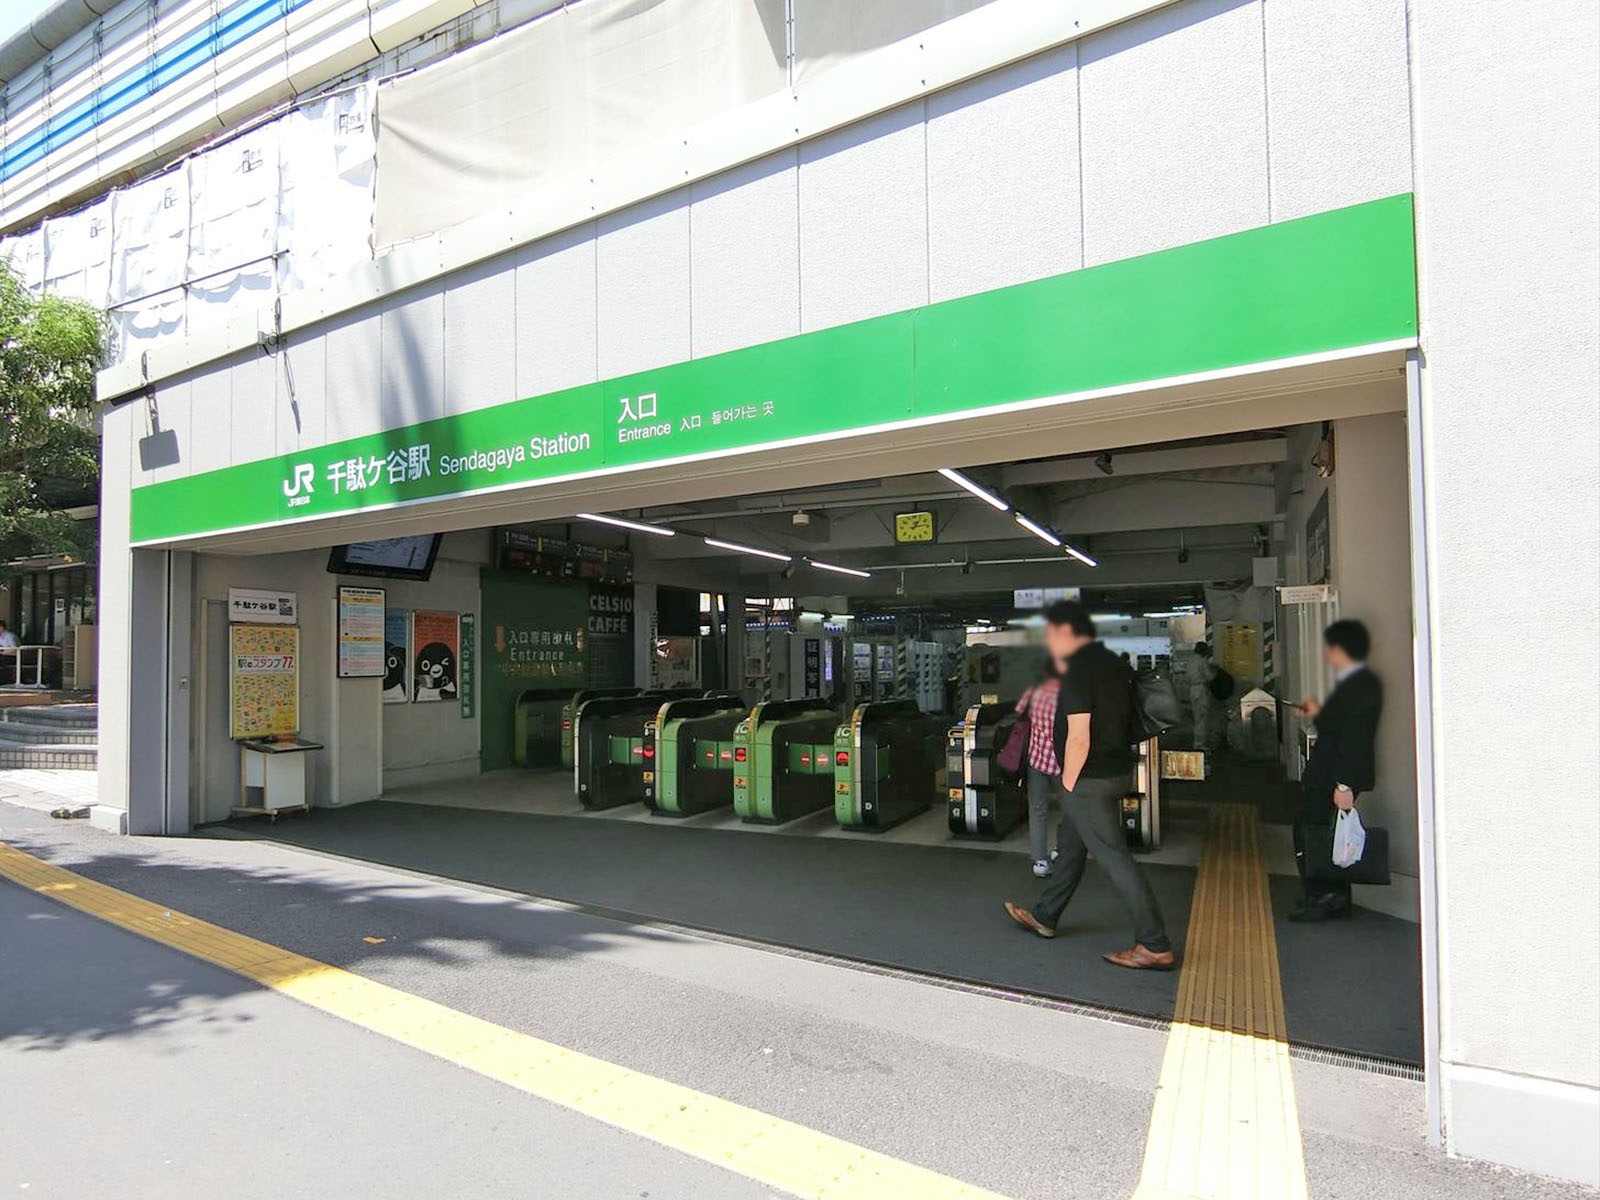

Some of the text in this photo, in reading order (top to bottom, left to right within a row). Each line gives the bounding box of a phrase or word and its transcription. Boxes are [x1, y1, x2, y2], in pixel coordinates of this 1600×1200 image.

[617, 393, 657, 423] 入口
[711, 400, 774, 425] 들어가는 곳
[618, 422, 672, 443] Entrance
[679, 415, 701, 432] 入口
[439, 432, 591, 475] Sendagaya Station
[284, 463, 314, 496] JR
[327, 443, 431, 495] 千駄ケ谷駅
[510, 647, 564, 662] Entrance
[735, 723, 747, 734] IC
[836, 727, 851, 737] IC
